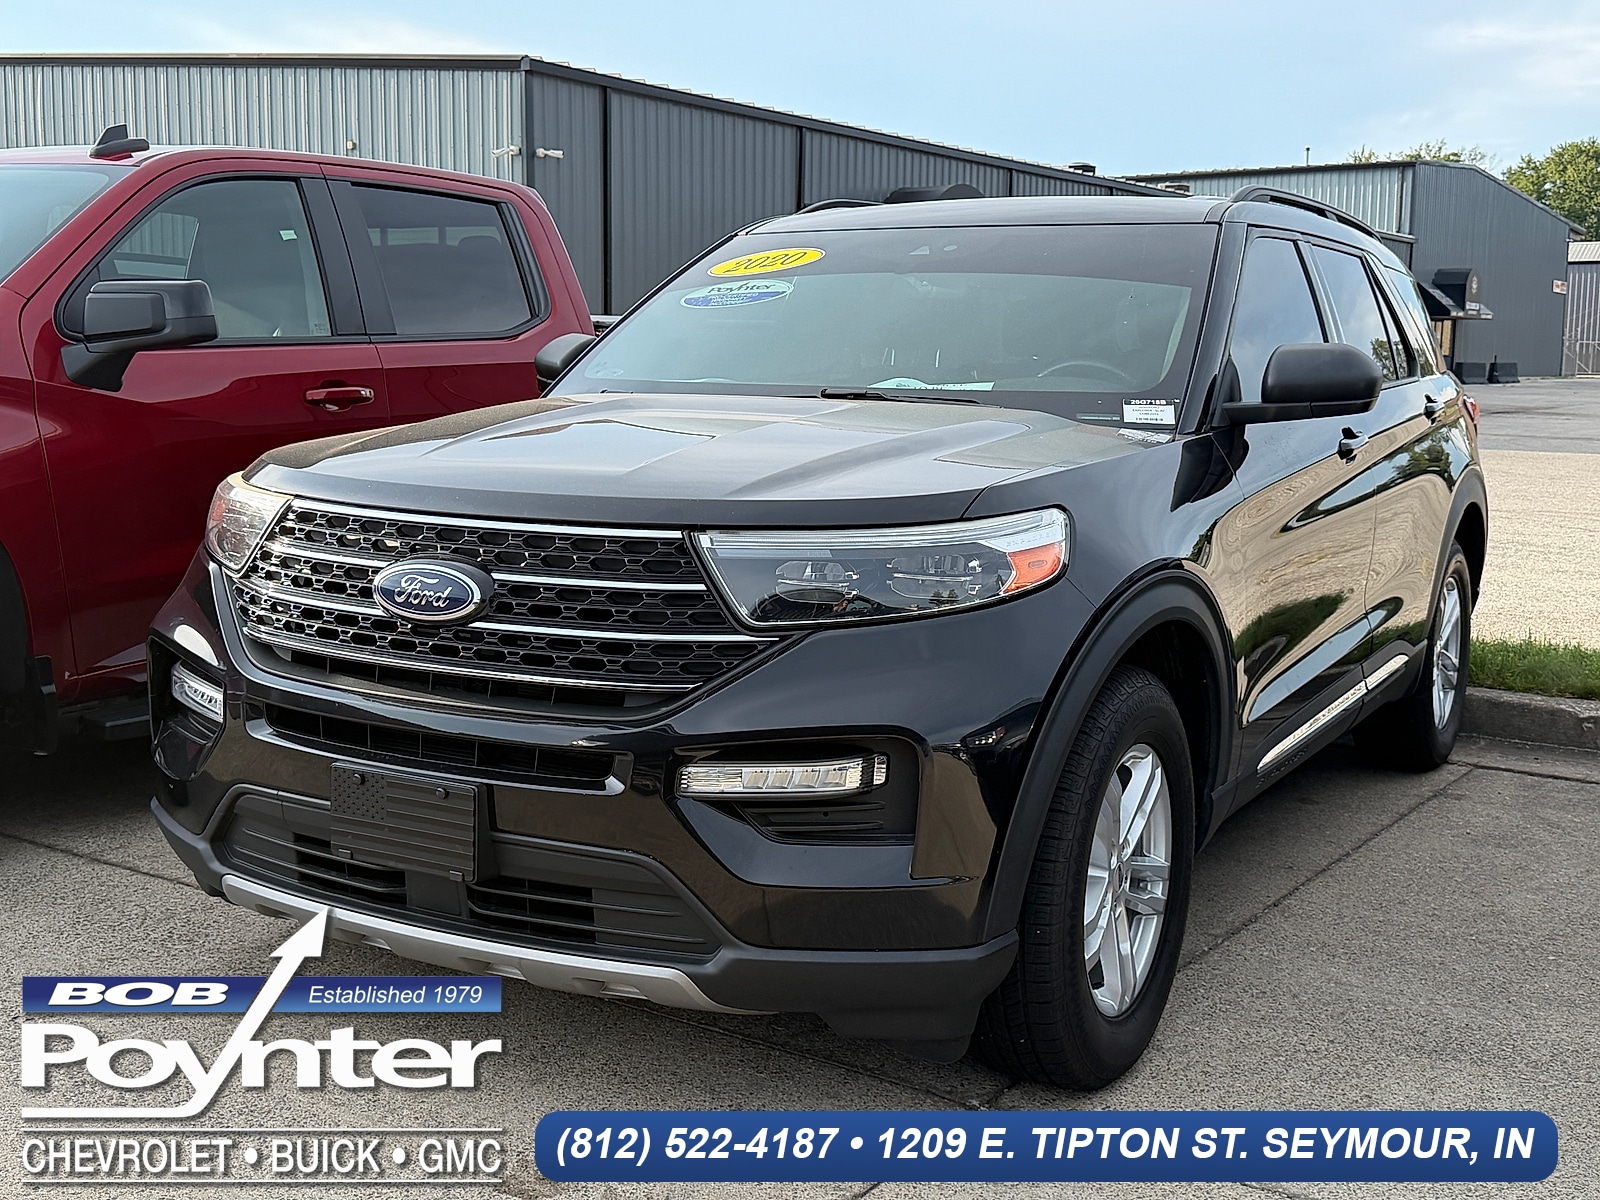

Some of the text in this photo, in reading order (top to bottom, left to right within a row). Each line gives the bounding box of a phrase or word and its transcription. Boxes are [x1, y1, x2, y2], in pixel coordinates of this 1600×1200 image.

[722, 251, 807, 274] 2020
[708, 281, 776, 294] Poynter
[394, 574, 453, 608] Ford
